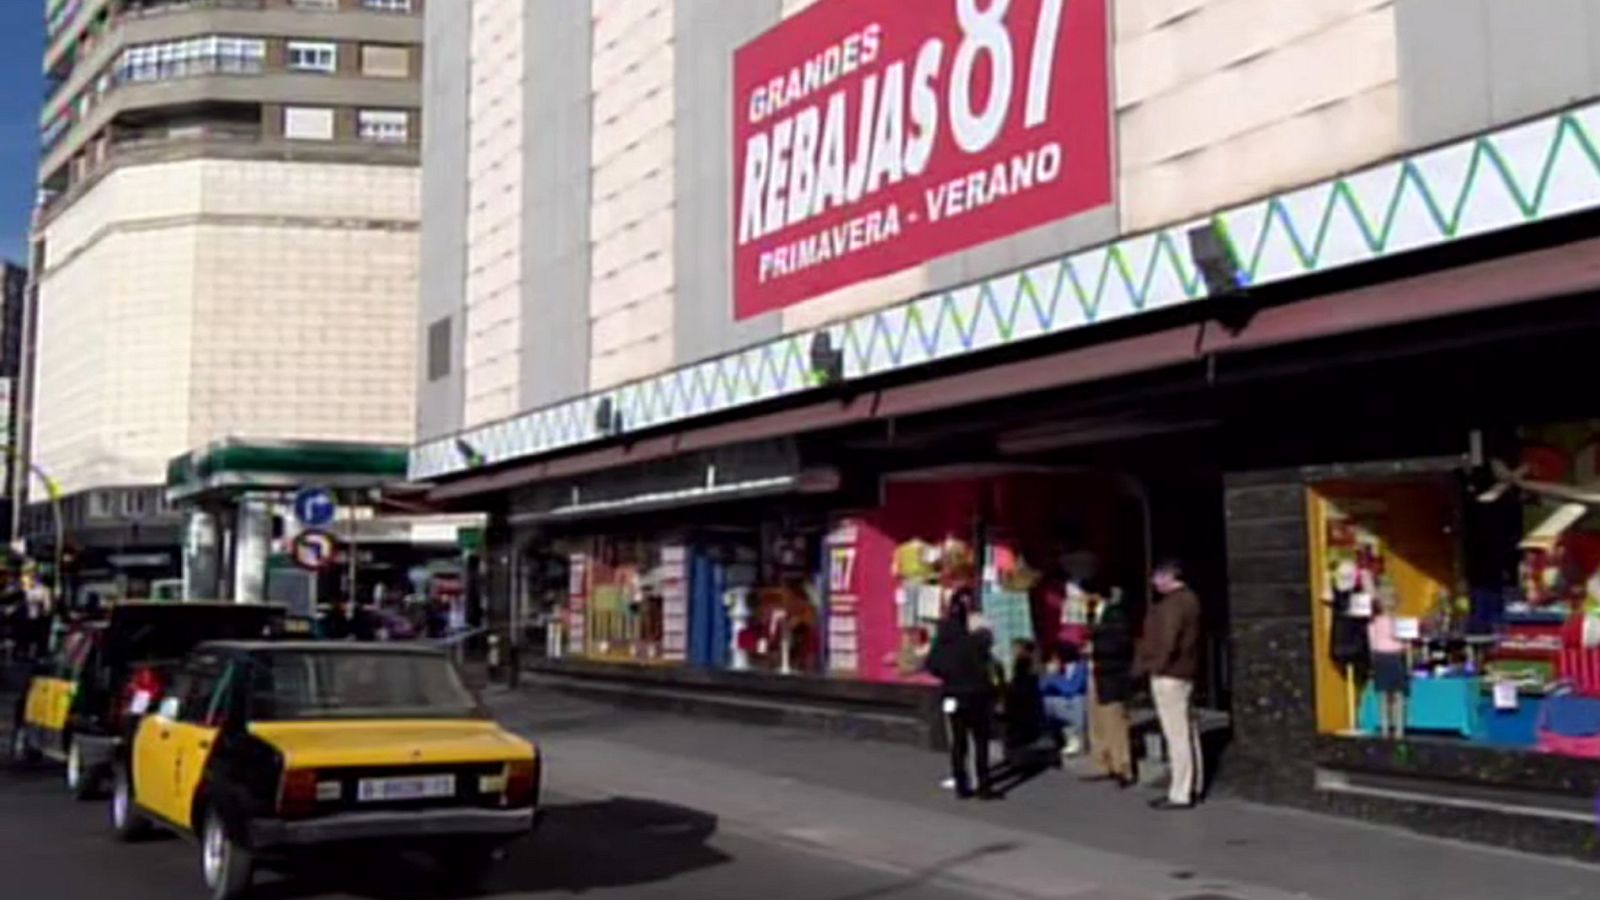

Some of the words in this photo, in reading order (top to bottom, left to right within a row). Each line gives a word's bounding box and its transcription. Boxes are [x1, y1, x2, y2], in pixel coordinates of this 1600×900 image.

[739, 38, 943, 245] REBAJAS
[749, 23, 881, 123] GRANDES
[758, 205, 901, 284] PRIMAVERA
[925, 143, 1062, 223] VERANO
